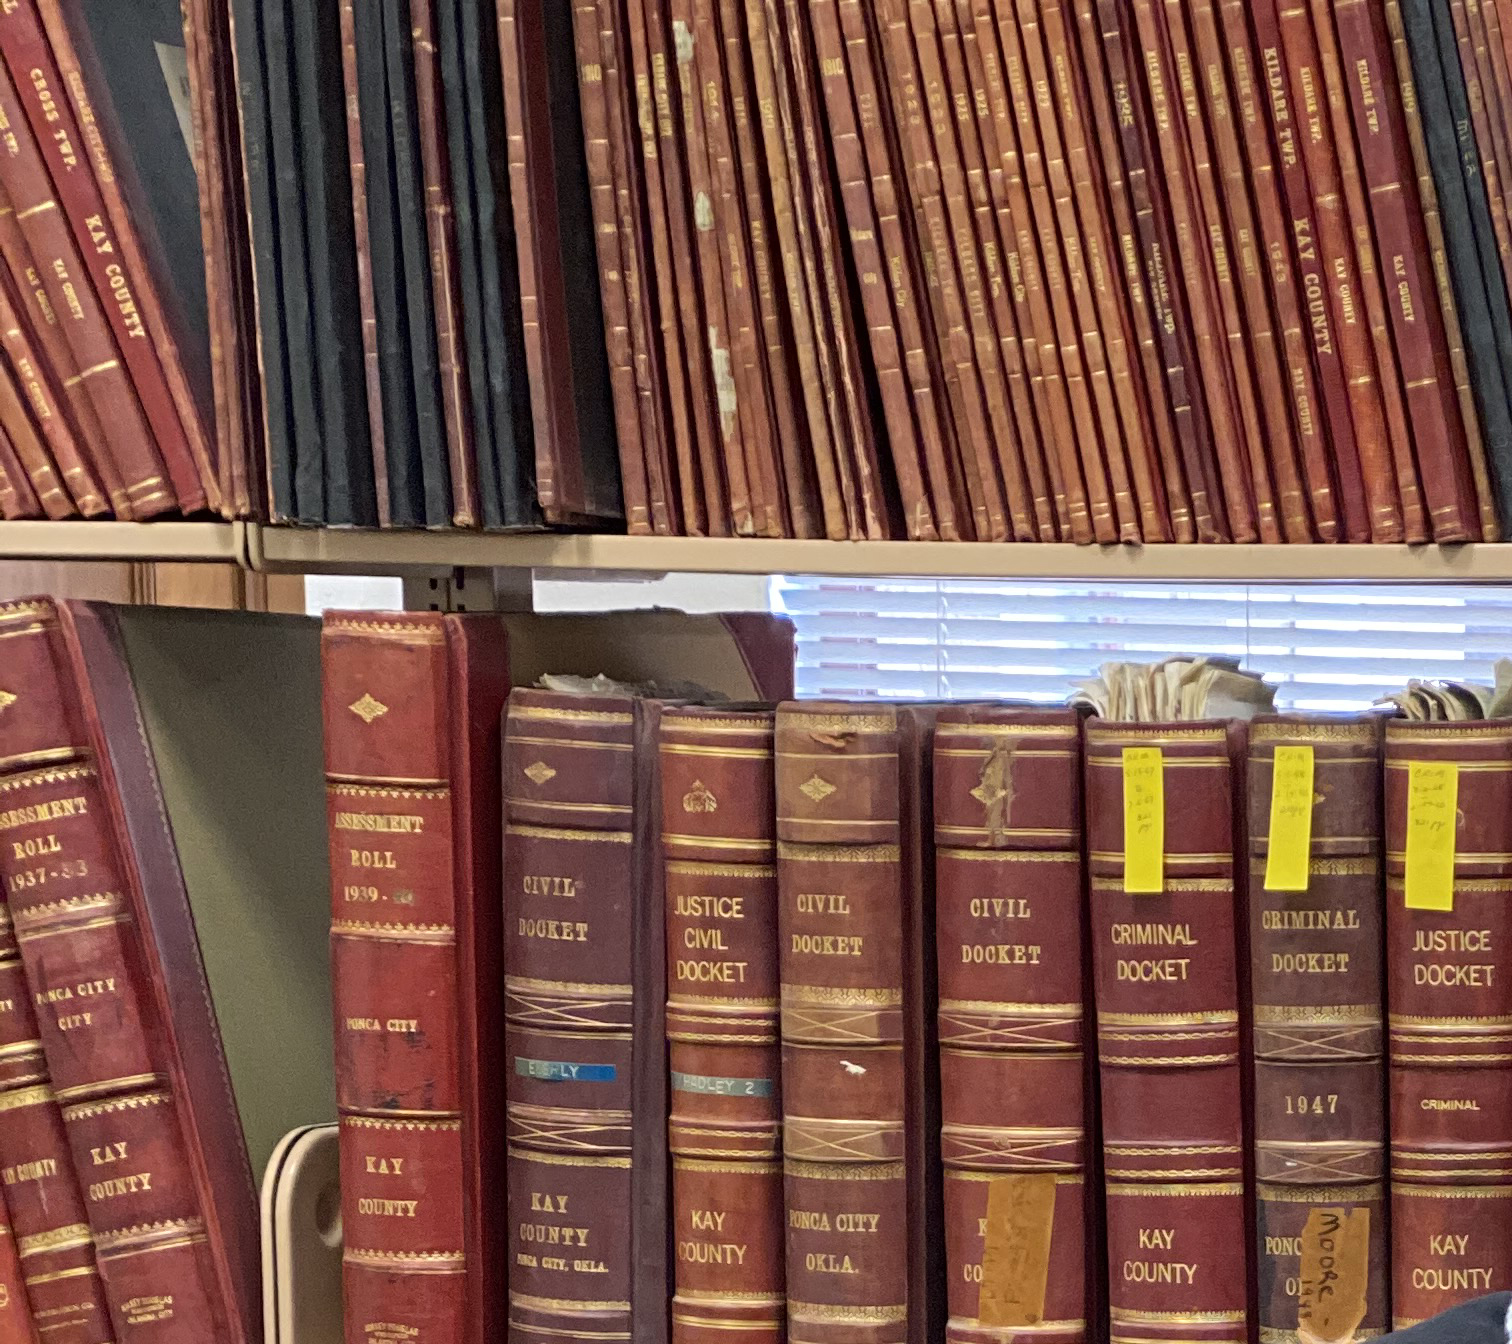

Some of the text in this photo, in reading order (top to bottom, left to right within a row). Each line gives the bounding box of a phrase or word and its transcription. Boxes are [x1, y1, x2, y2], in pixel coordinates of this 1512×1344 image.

[30, 67, 59, 122] CROSS
[1264, 47, 1297, 169] KILDARE TWP.
[85, 214, 113, 254] KAY
[105, 264, 145, 338] COUNTY
[1294, 217, 1332, 356] KAY COUNTY
[13, 835, 62, 860] ROLL
[350, 849, 397, 870] ROLL
[523, 876, 577, 897] CIVIL
[673, 896, 744, 919] JUSTICE
[797, 894, 850, 913] CIVIL
[970, 898, 1031, 919] CIVIL
[1262, 910, 1360, 930] CRIMINAL
[518, 921, 589, 942] DOCKET
[684, 928, 729, 950] CIVIL
[1111, 924, 1197, 945] CRIMINAL
[1412, 931, 1492, 952] JUSTICE
[791, 935, 863, 956] DOCKET
[962, 943, 1041, 966] DOCKET
[676, 960, 748, 984] DOCKET
[1117, 959, 1190, 982] DOCKET
[1272, 953, 1349, 973] DOCKET
[1414, 965, 1494, 987] DOCKET
[76, 977, 117, 1000] CITY
[58, 1013, 93, 1031] CITY
[387, 1018, 418, 1032] CITY
[745, 1080, 755, 1095] 2
[1285, 1095, 1339, 1115] 1947
[1421, 1099, 1480, 1111] CRIMINAL
[90, 1141, 129, 1166] KAY
[365, 1156, 404, 1174] KAY
[88, 1173, 152, 1202] COUNTY
[357, 1199, 418, 1217] COUNTY
[531, 1193, 569, 1213] KAY
[691, 1210, 726, 1231] KAY
[789, 1209, 880, 1234] PONCA CITY
[519, 1224, 589, 1247] COUNTY
[1139, 1229, 1174, 1250] KAY
[1430, 1234, 1469, 1256] KAY
[679, 1242, 747, 1265] COUNTY
[805, 1252, 860, 1274] OKLA.
[1123, 1263, 1197, 1285] COUNTY
[1412, 1268, 1493, 1289] COUNTY
